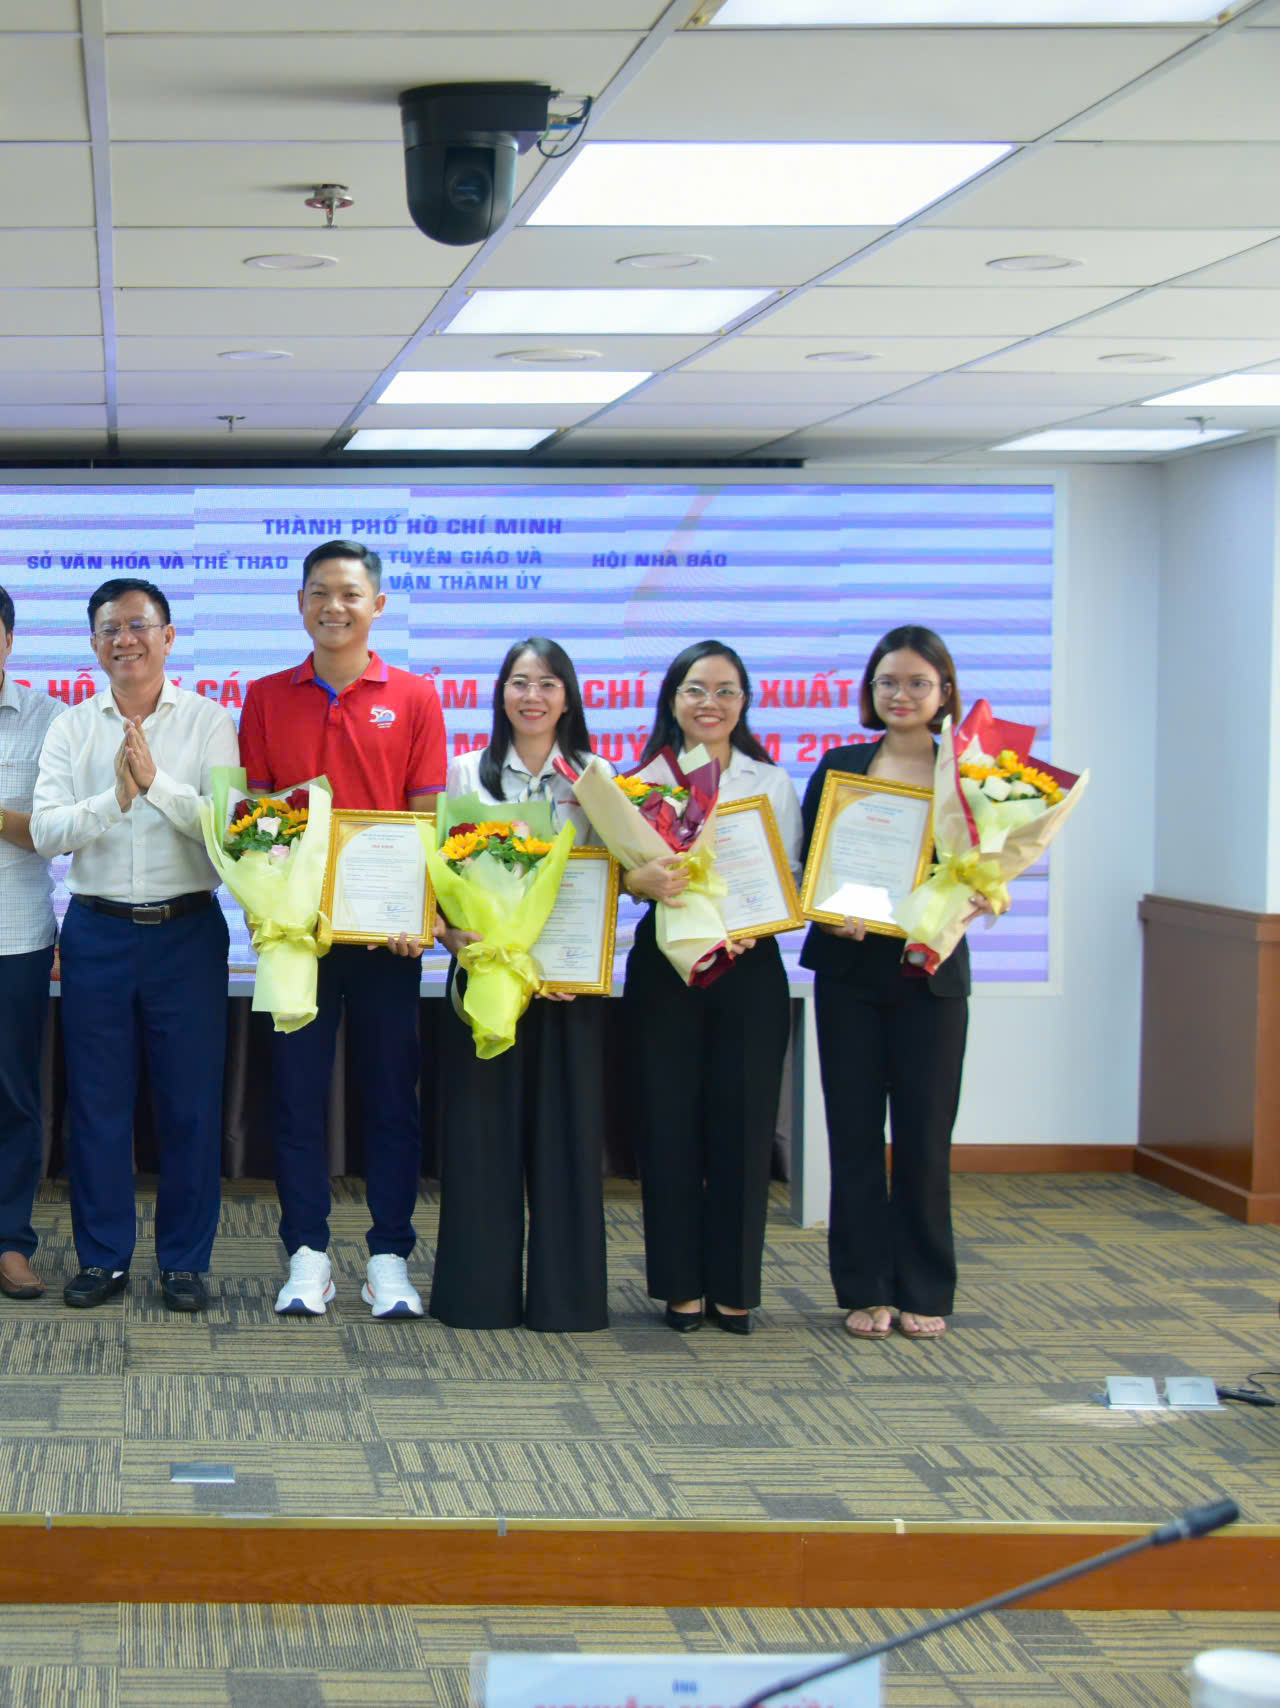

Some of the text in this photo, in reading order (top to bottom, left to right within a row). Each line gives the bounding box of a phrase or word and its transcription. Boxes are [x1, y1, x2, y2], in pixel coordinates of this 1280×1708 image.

[263, 514, 562, 534] THÀNH PHỐ HỒ CHÍ MINH
[27, 550, 288, 569] SỞ VĂN HÓA VÀ THỂ THAO
[388, 546, 543, 564] TUYÊN GIÁO VÀ
[592, 550, 627, 569] HỘI
[686, 550, 727, 567] BÁO
[389, 570, 542, 592] VẬN THÀNH ỦY
[48, 667, 96, 705] HỖ
[196, 671, 257, 708] CÁ
[583, 669, 648, 708] CHÍ
[759, 669, 854, 708] XUẤT
